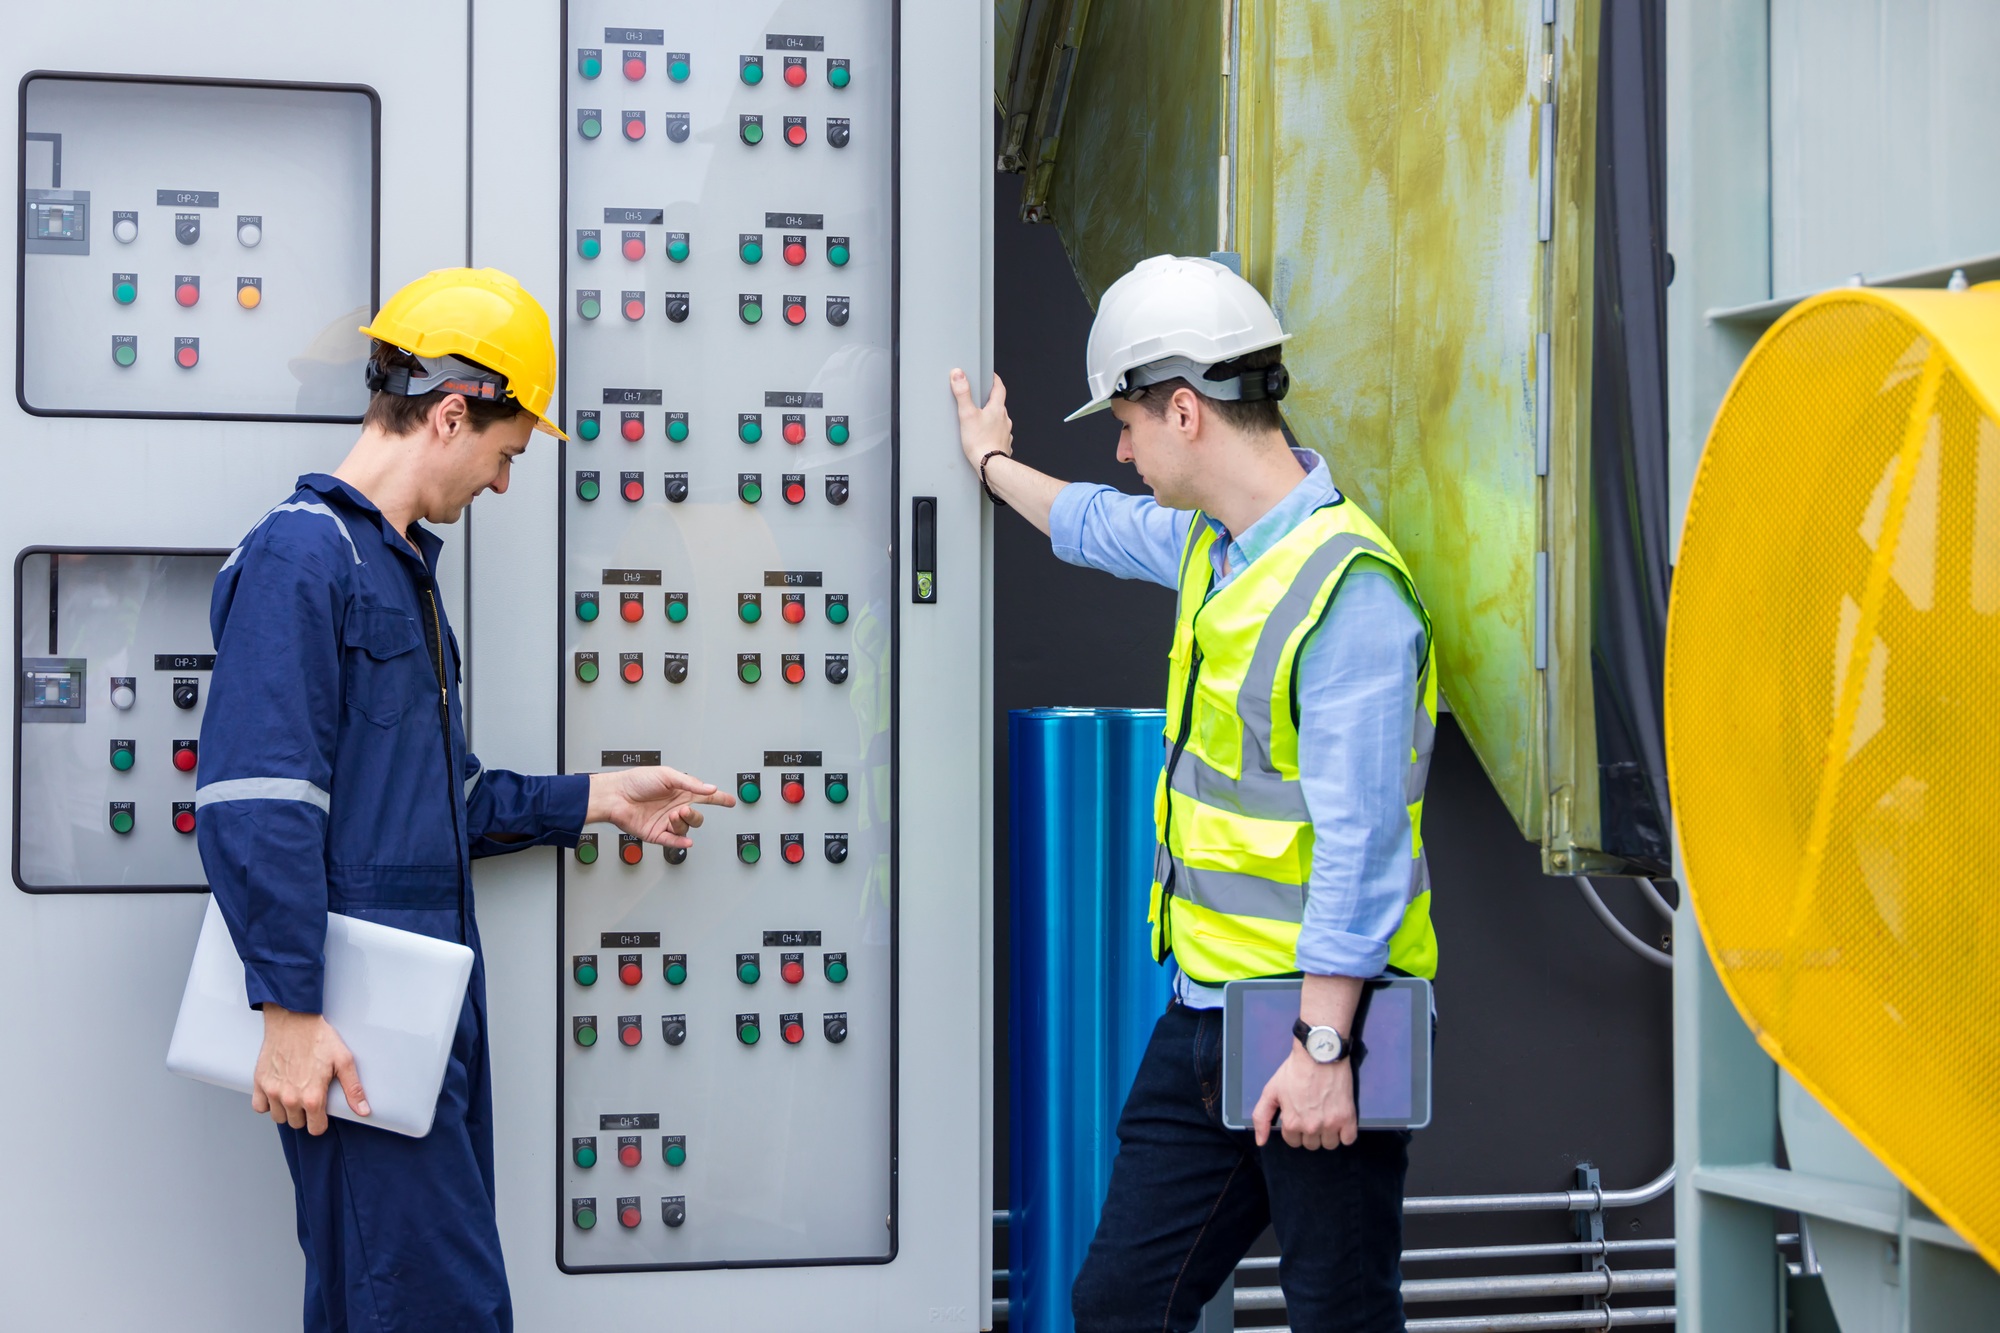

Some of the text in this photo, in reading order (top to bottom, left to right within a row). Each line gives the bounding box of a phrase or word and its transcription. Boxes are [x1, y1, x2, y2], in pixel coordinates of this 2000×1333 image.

[625, 31, 643, 41] CH-3
[786, 38, 804, 48] CH-4
[176, 194, 200, 204] CHP-2
[624, 211, 642, 221] CH-5
[785, 216, 803, 226] CH-6
[623, 392, 641, 402] CH-7
[784, 395, 802, 405] CH-8
[623, 572, 641, 582] CH-9
[784, 574, 803, 584] CH-10
[174, 658, 198, 668] CHP-3
[622, 754, 641, 764] CH-11
[783, 754, 802, 764] CH-12
[620, 935, 640, 945] CH-13
[782, 934, 801, 944] CH-14
[620, 1116, 640, 1126] CH-15
